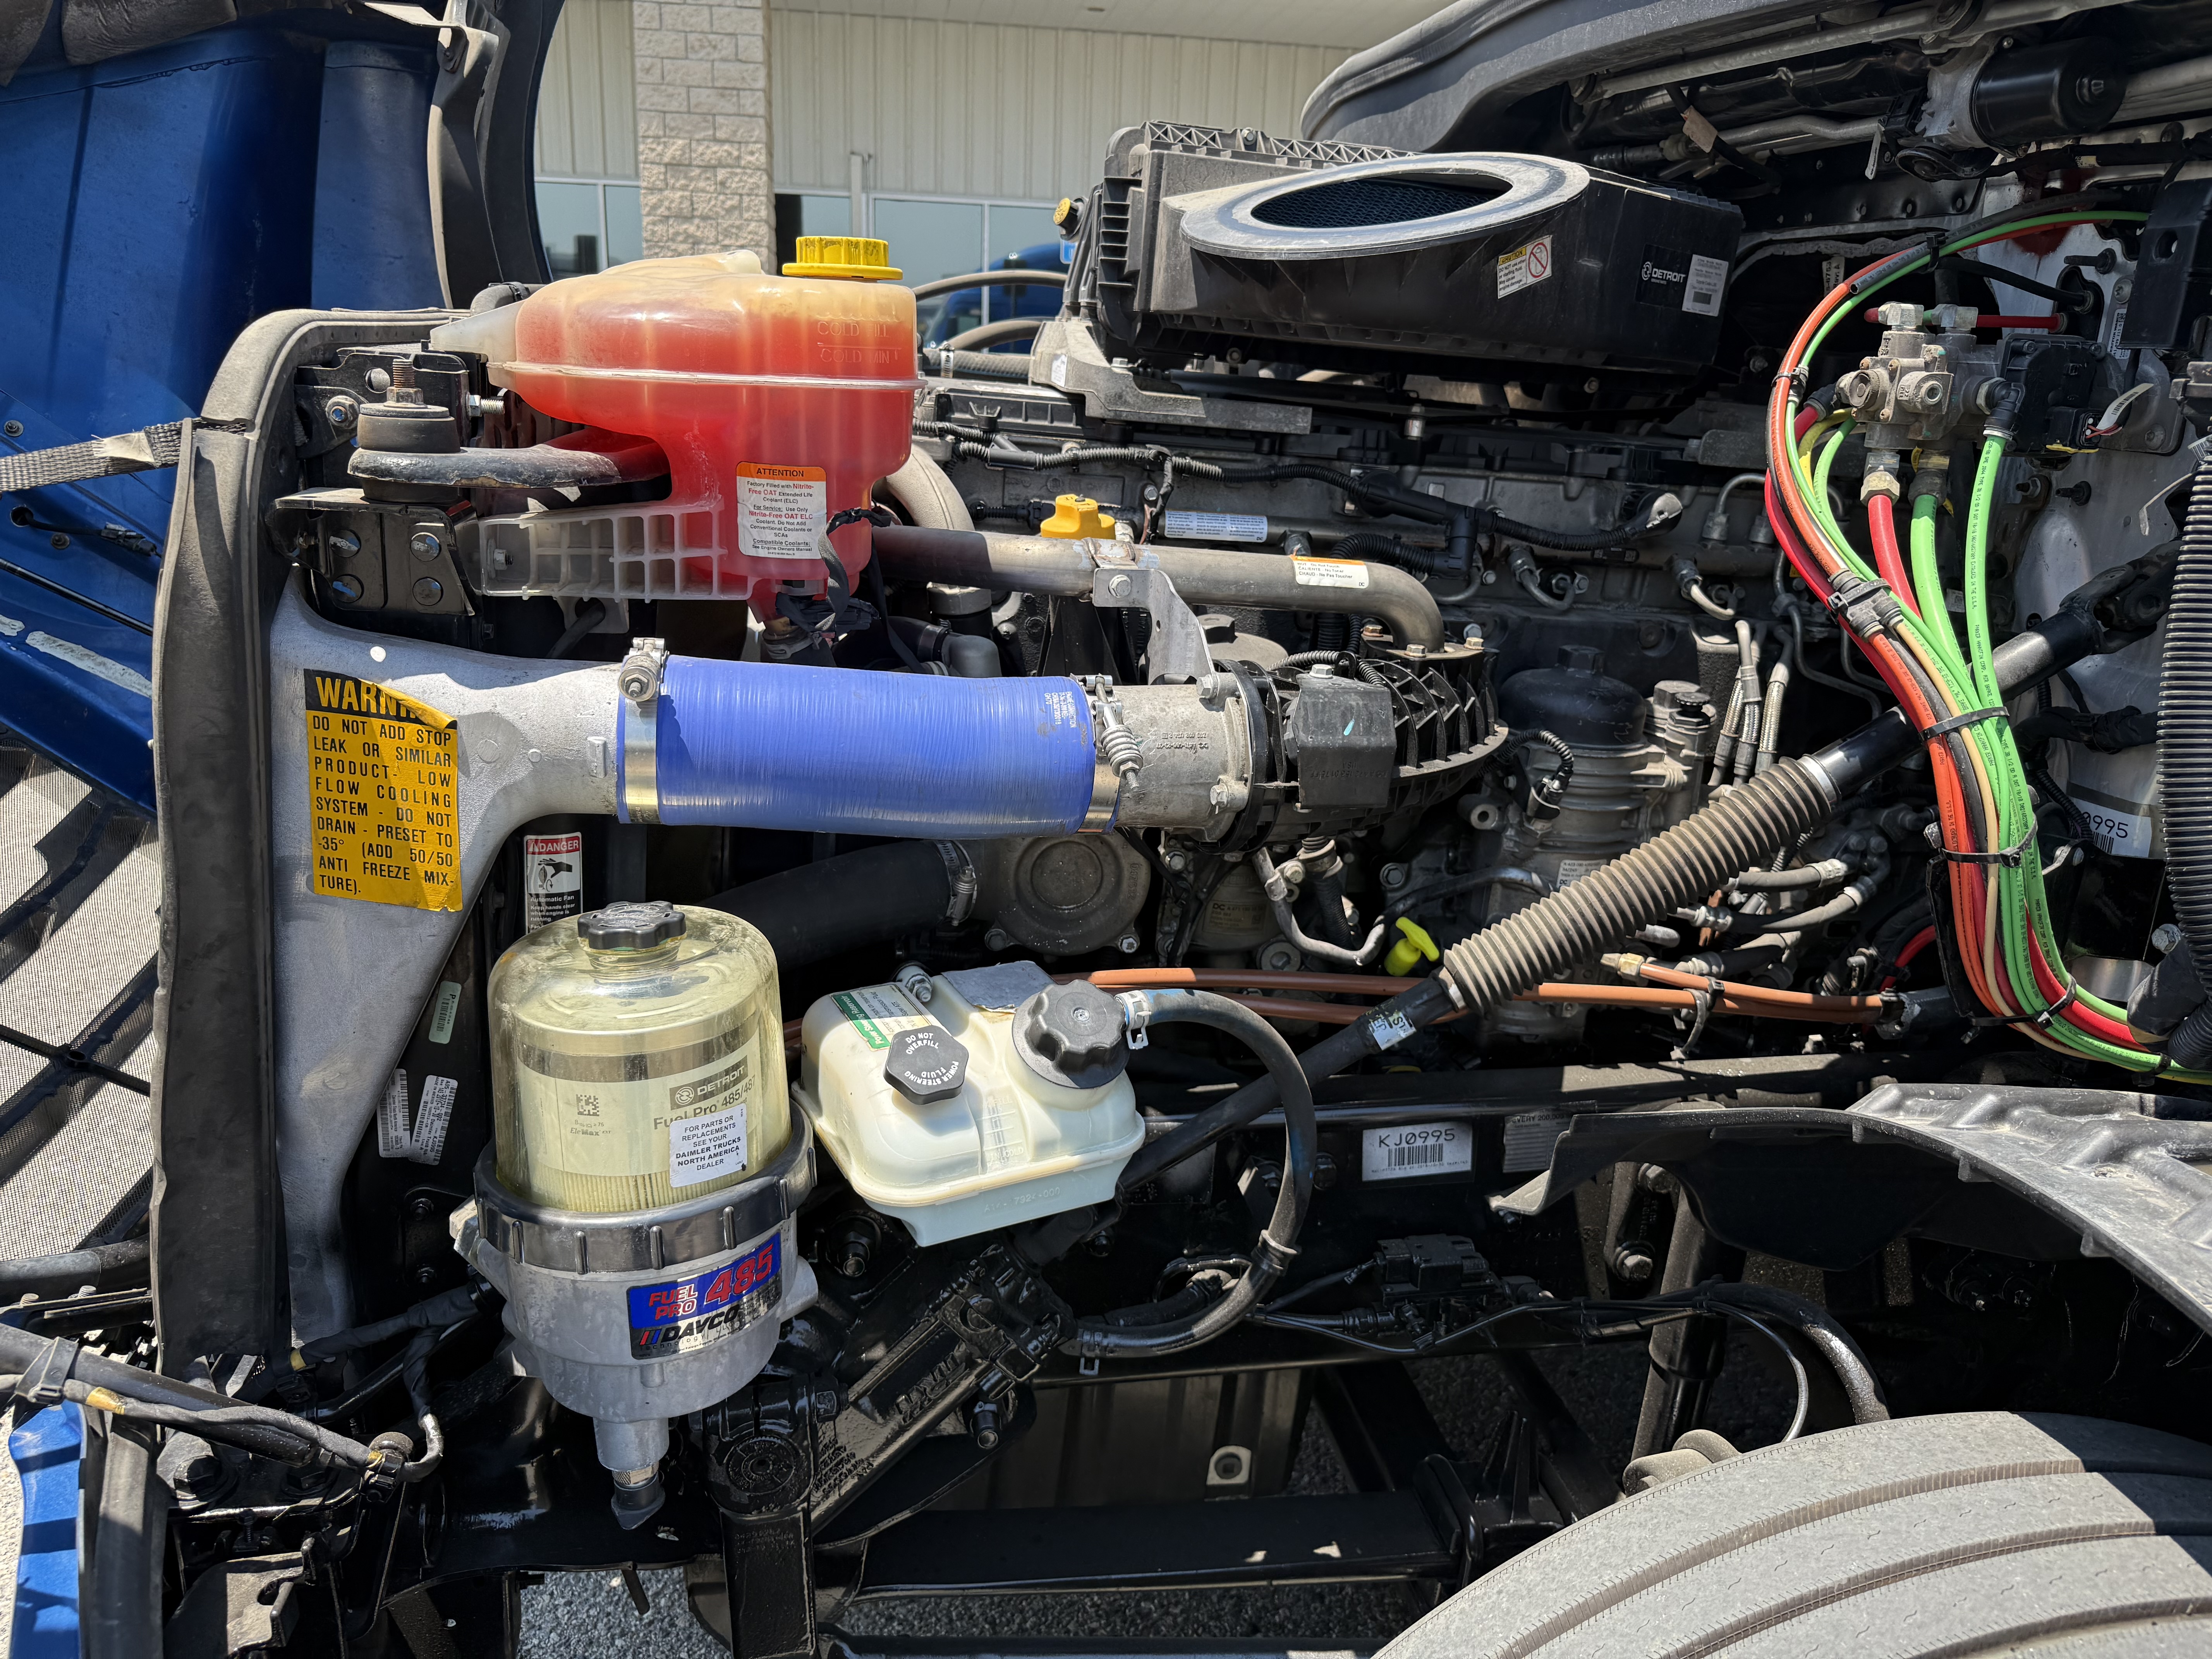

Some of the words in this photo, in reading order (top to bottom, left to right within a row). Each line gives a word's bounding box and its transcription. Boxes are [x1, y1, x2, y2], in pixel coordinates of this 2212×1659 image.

[1502, 250, 1523, 263] CAUTION
[1652, 268, 1686, 282] DETROIT
[817, 322, 859, 336] COLD
[821, 349, 861, 362] COLD
[757, 468, 804, 477] ATTENTION
[313, 716, 330, 731] DO
[342, 720, 367, 735] NOT
[380, 724, 405, 740] ADD
[417, 729, 451, 746] STOP
[314, 737, 347, 753] LEAK
[363, 742, 379, 757] OR
[396, 747, 450, 768] SIMILAR
[2000, 738, 2009, 750] TYPE
[418, 770, 451, 788] LOW
[316, 777, 359, 795] FLOW
[377, 785, 451, 808] COOLING
[316, 797, 368, 816] SYSTEM
[397, 808, 413, 822] DO
[427, 812, 451, 827] NOT
[318, 816, 356, 835] DRAIN
[378, 824, 426, 843] PRESET
[436, 833, 452, 847] TO
[362, 842, 392, 859] (ADD
[410, 848, 453, 867] 50/50
[539, 840, 579, 852] DANGER
[319, 856, 347, 872] ANTI
[363, 862, 410, 881] FREEZE
[424, 871, 454, 886] MIX-
[319, 875, 361, 895] TURE).
[840, 995, 860, 1014] Reservoir
[905, 1035, 916, 1044] DO
[906, 1039, 939, 1054] OVERFILL
[697, 1065, 744, 1095] DETROIT
[904, 1070, 942, 1085] STEERING
[921, 1066, 946, 1077] FLUID
[940, 1061, 959, 1082] POWER
[694, 1103, 717, 1116] Pro
[721, 1074, 756, 1108] 485/487
[682, 1122, 736, 1142] REPLACEMENTS
[701, 1119, 723, 1130] PARTS
[676, 1147, 711, 1159] DAIMLER
[713, 1137, 741, 1150] TRUCKS
[709, 1133, 727, 1144] YOUR
[1379, 1128, 1455, 1148] KJ0995
[677, 1156, 706, 1166] NORTH
[708, 1146, 740, 1160] AMERICA
[697, 1159, 724, 1171] DEALER
[649, 1284, 698, 1307] FUEL
[704, 1243, 773, 1305] 485
[655, 1299, 697, 1320] PRO
[661, 1304, 740, 1343] DAYCO
